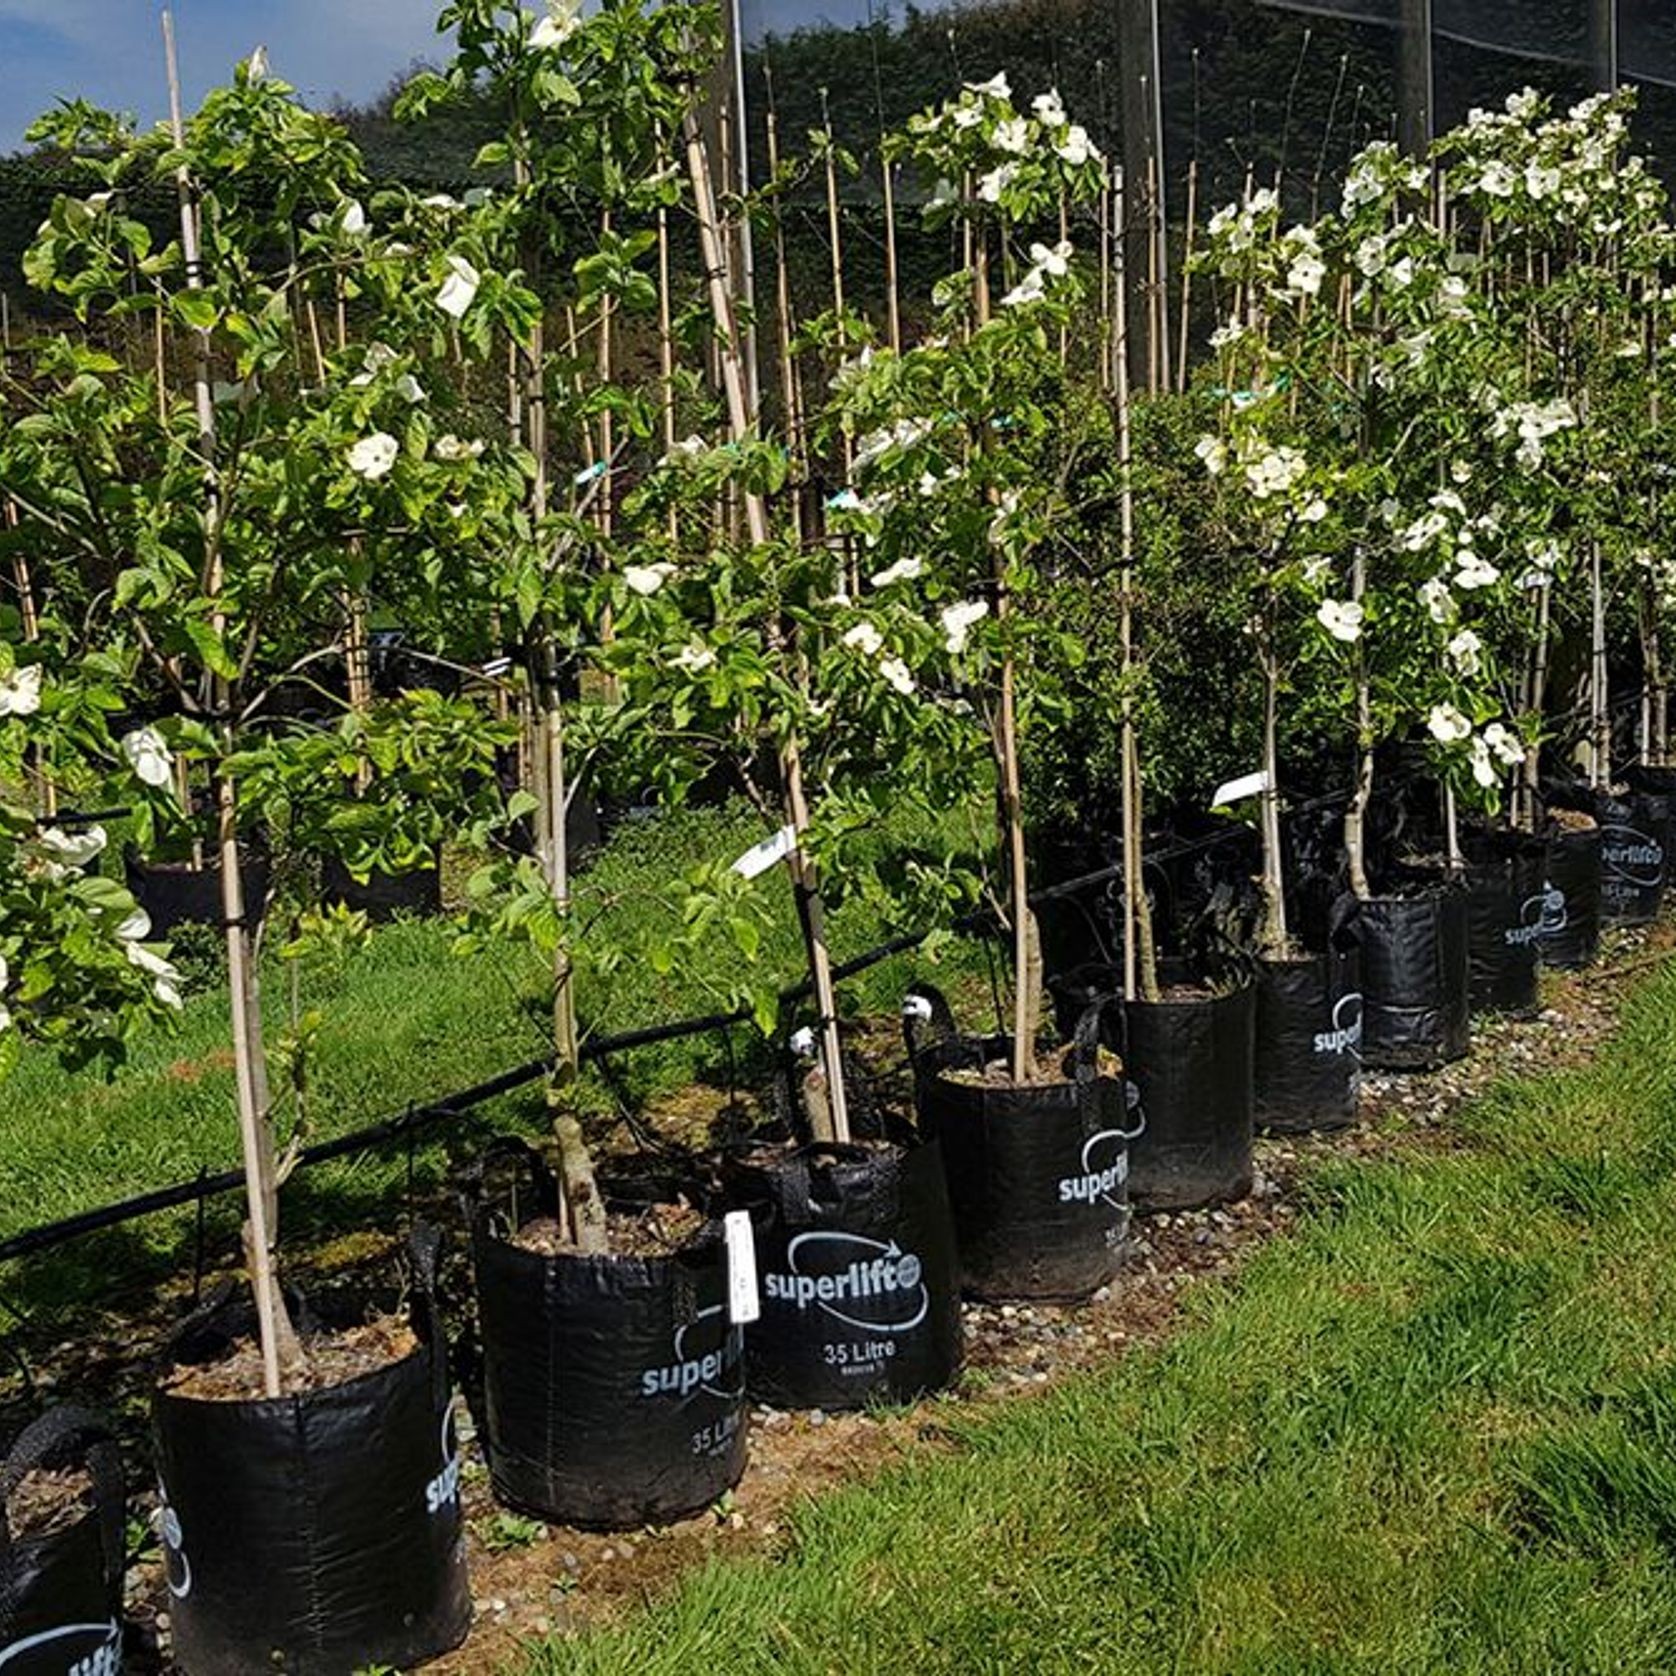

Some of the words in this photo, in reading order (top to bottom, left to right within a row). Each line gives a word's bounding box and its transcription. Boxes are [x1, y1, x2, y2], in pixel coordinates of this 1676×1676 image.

[765, 1258, 898, 1309] superlift
[824, 1344, 848, 1364] 35
[853, 1340, 896, 1362] Litre
